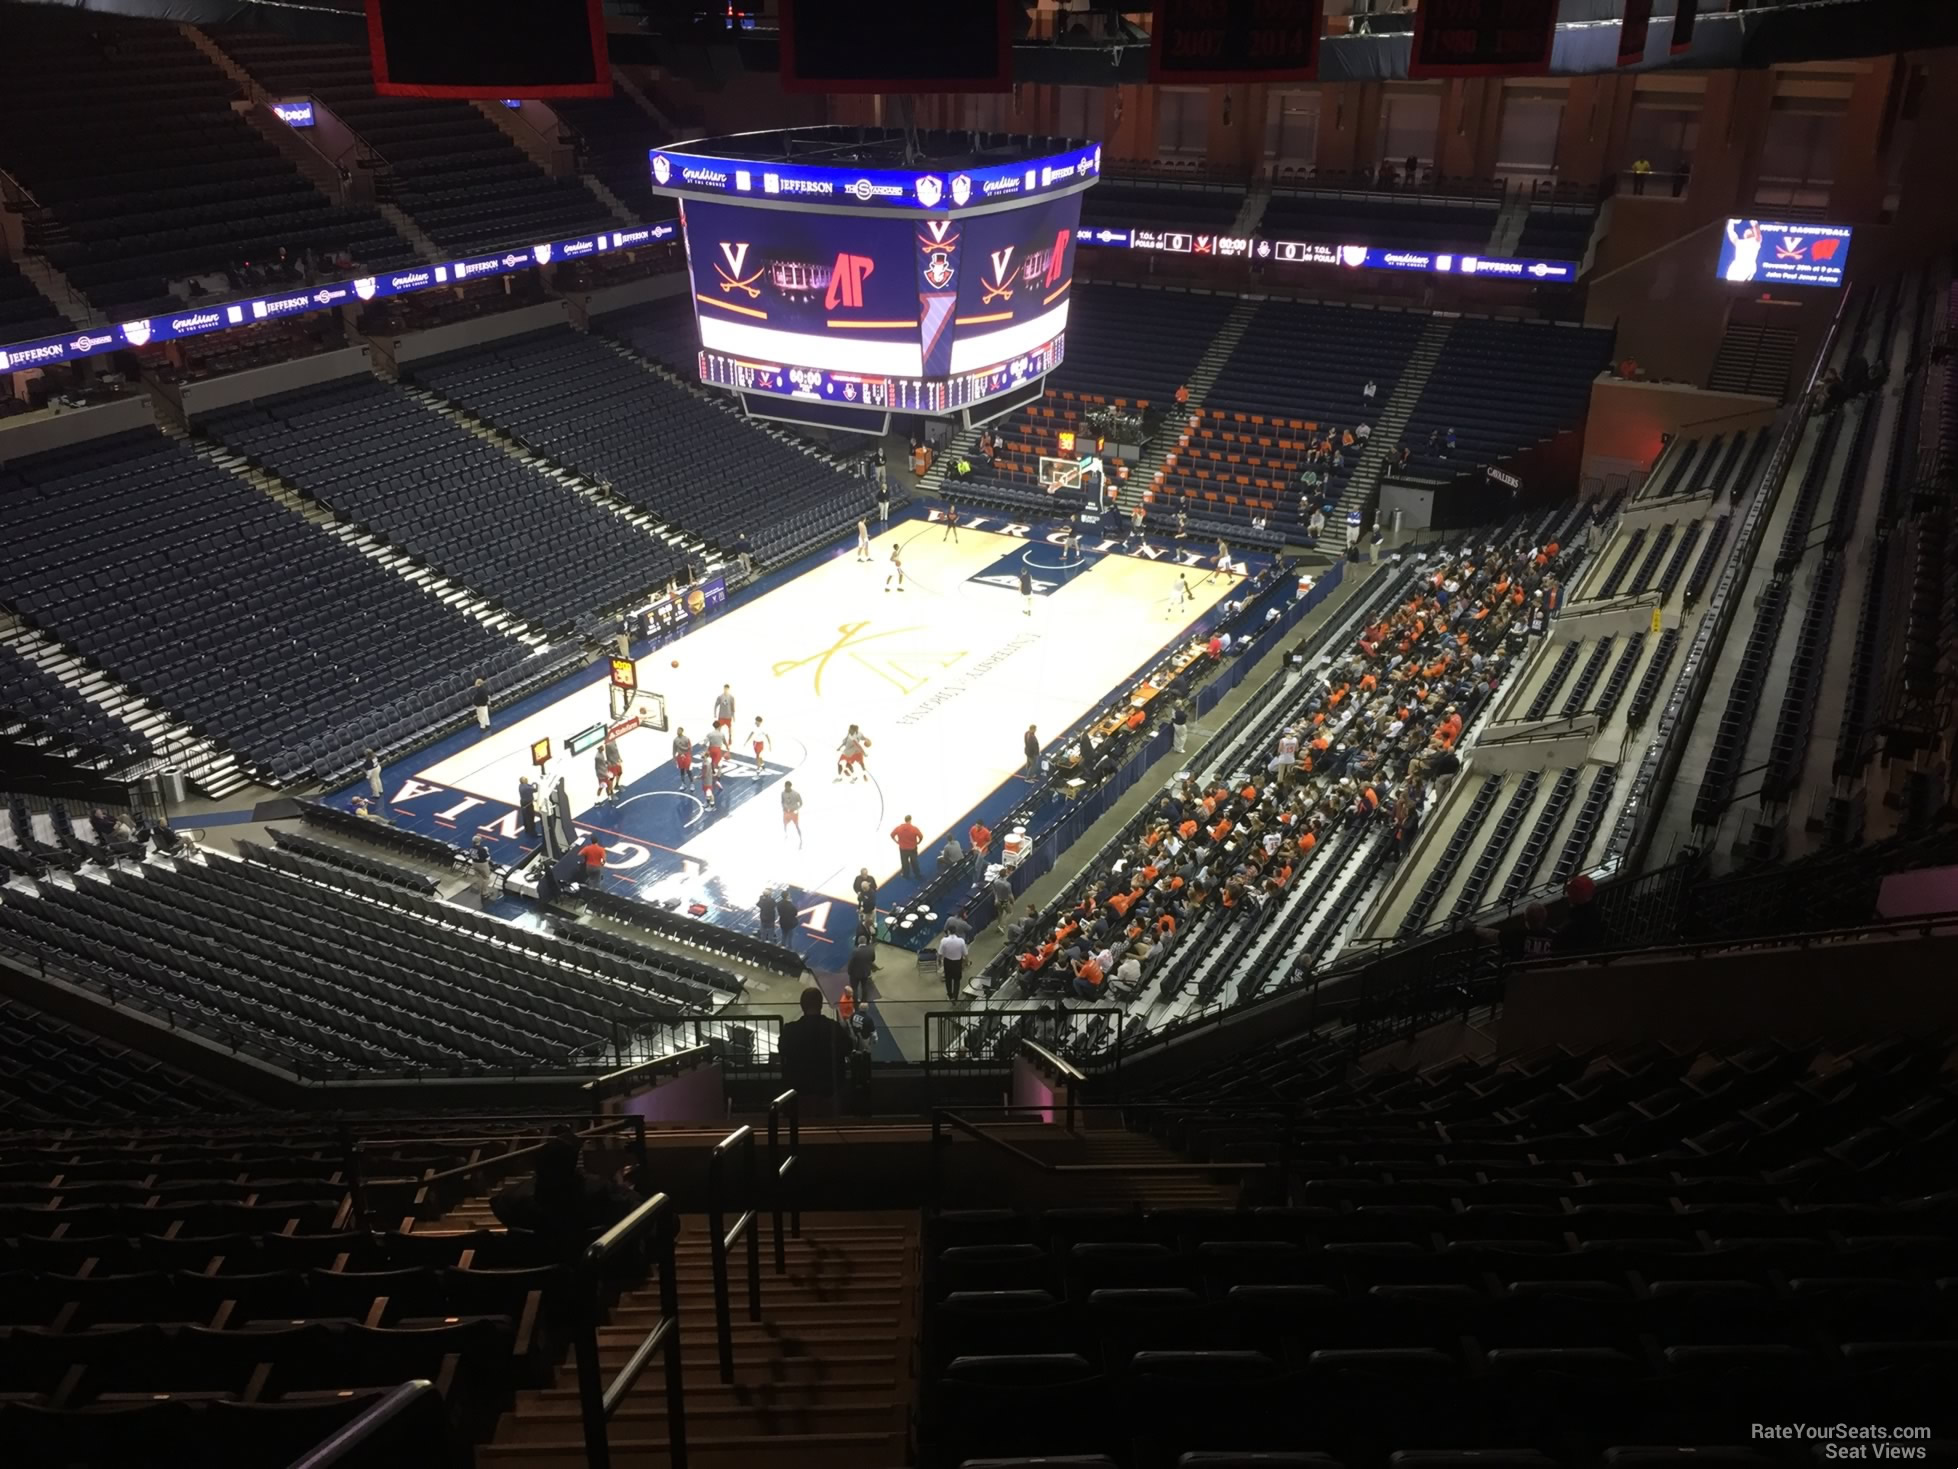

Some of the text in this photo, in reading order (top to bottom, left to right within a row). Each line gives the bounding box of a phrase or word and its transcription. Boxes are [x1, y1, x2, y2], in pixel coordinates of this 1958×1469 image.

[780, 178, 833, 193] JEFFERSON
[926, 220, 952, 244] V
[1135, 240, 1155, 248] FOULS
[1172, 235, 1182, 250] 0
[1285, 244, 1296, 259] 0
[1314, 254, 1335, 263] FOULS
[465, 259, 498, 274] JEFFERSON
[719, 242, 750, 281] V
[991, 245, 1015, 288] V
[266, 295, 309, 314] JEFFERSON
[8, 343, 63, 365] JEFFERSON
[789, 369, 822, 386] 60:00
[1487, 467, 1519, 488] CAVALIERS
